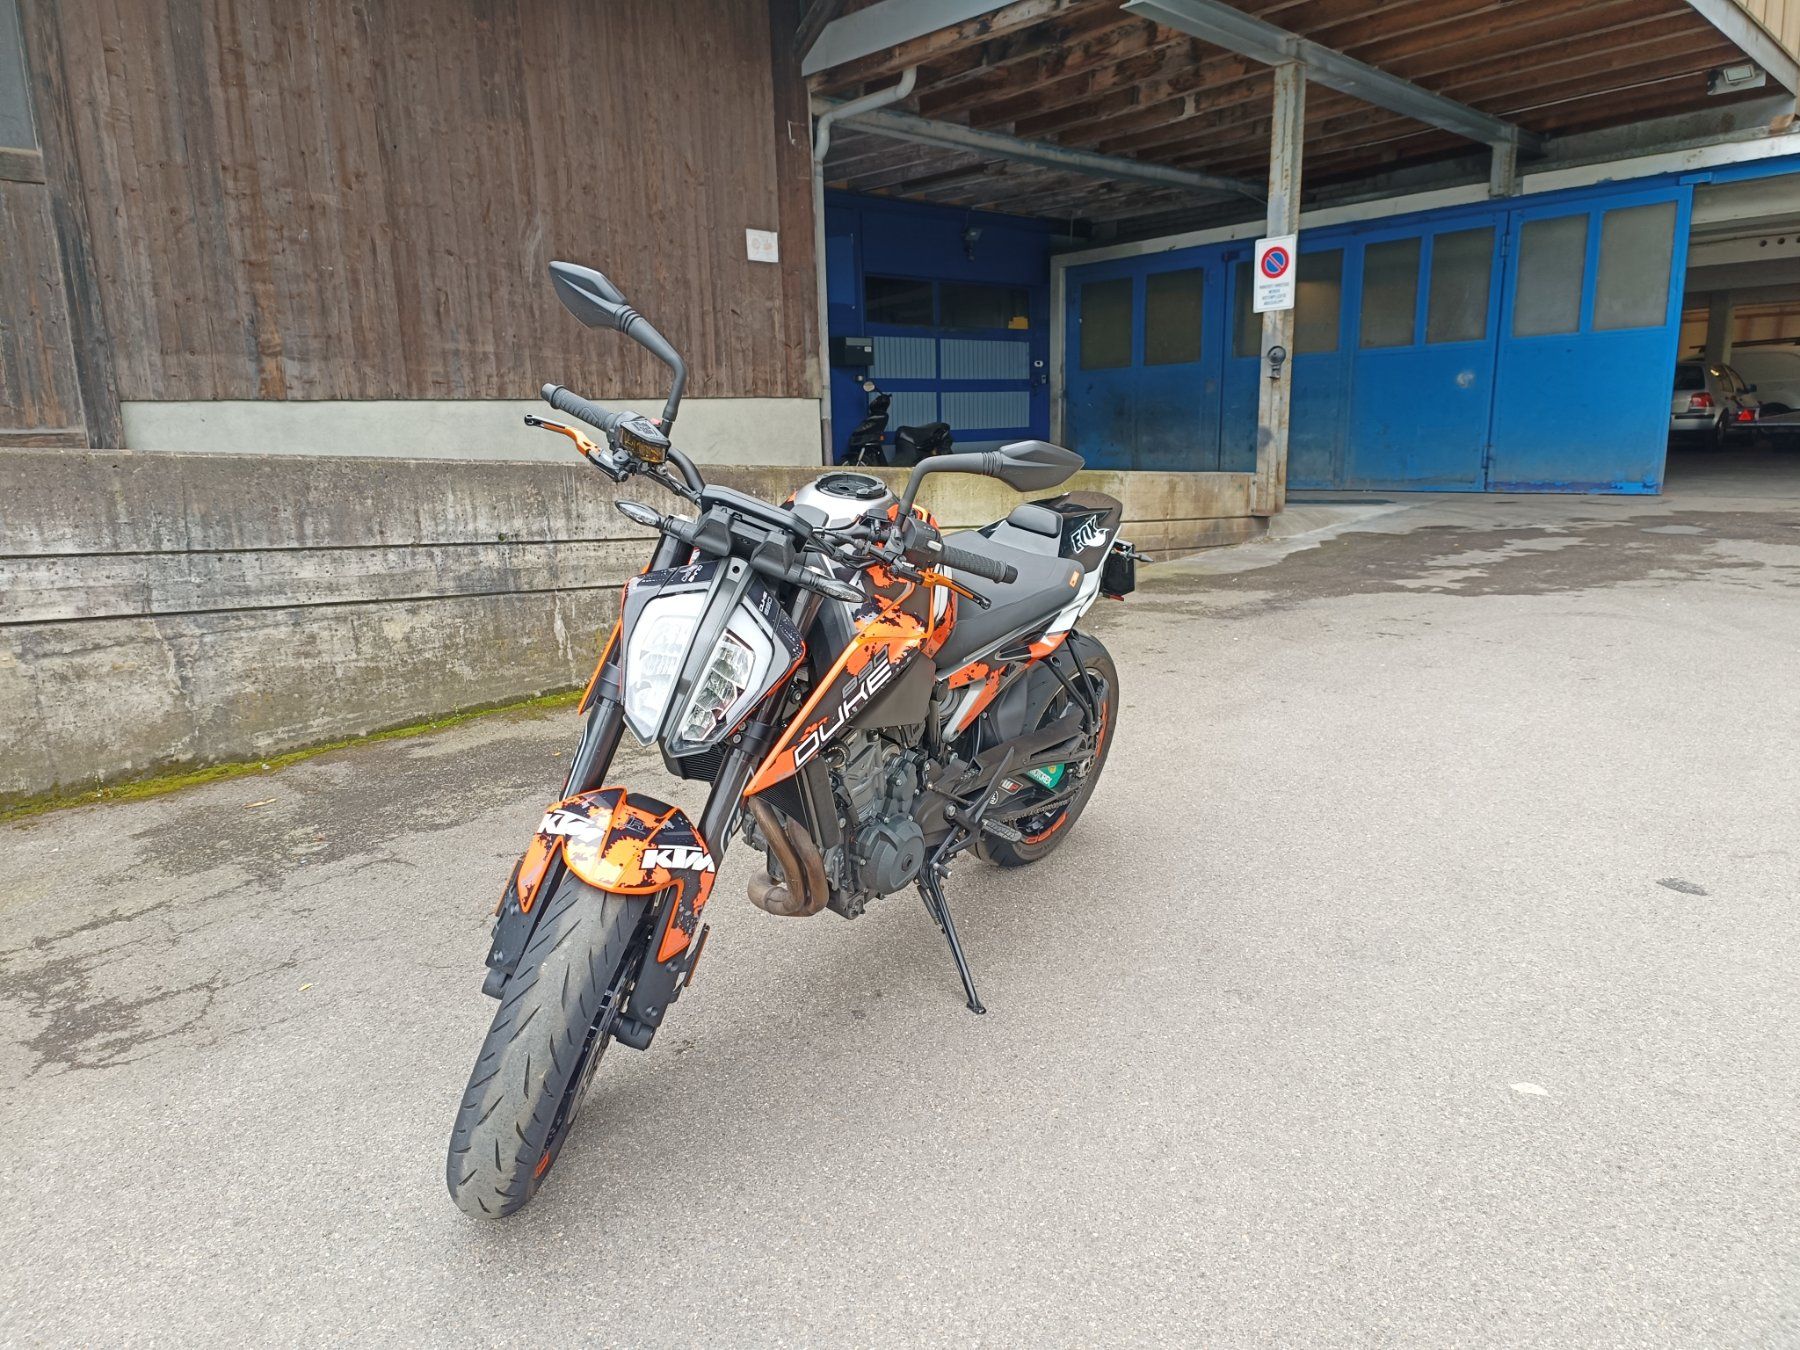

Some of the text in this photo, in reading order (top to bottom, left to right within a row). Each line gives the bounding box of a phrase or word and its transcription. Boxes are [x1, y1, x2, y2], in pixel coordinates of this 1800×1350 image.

[1071, 515, 1099, 554] FOX
[842, 645, 889, 698] 890
[794, 659, 892, 767] DUKE
[537, 810, 605, 842] KTM
[641, 845, 715, 873] KTM
